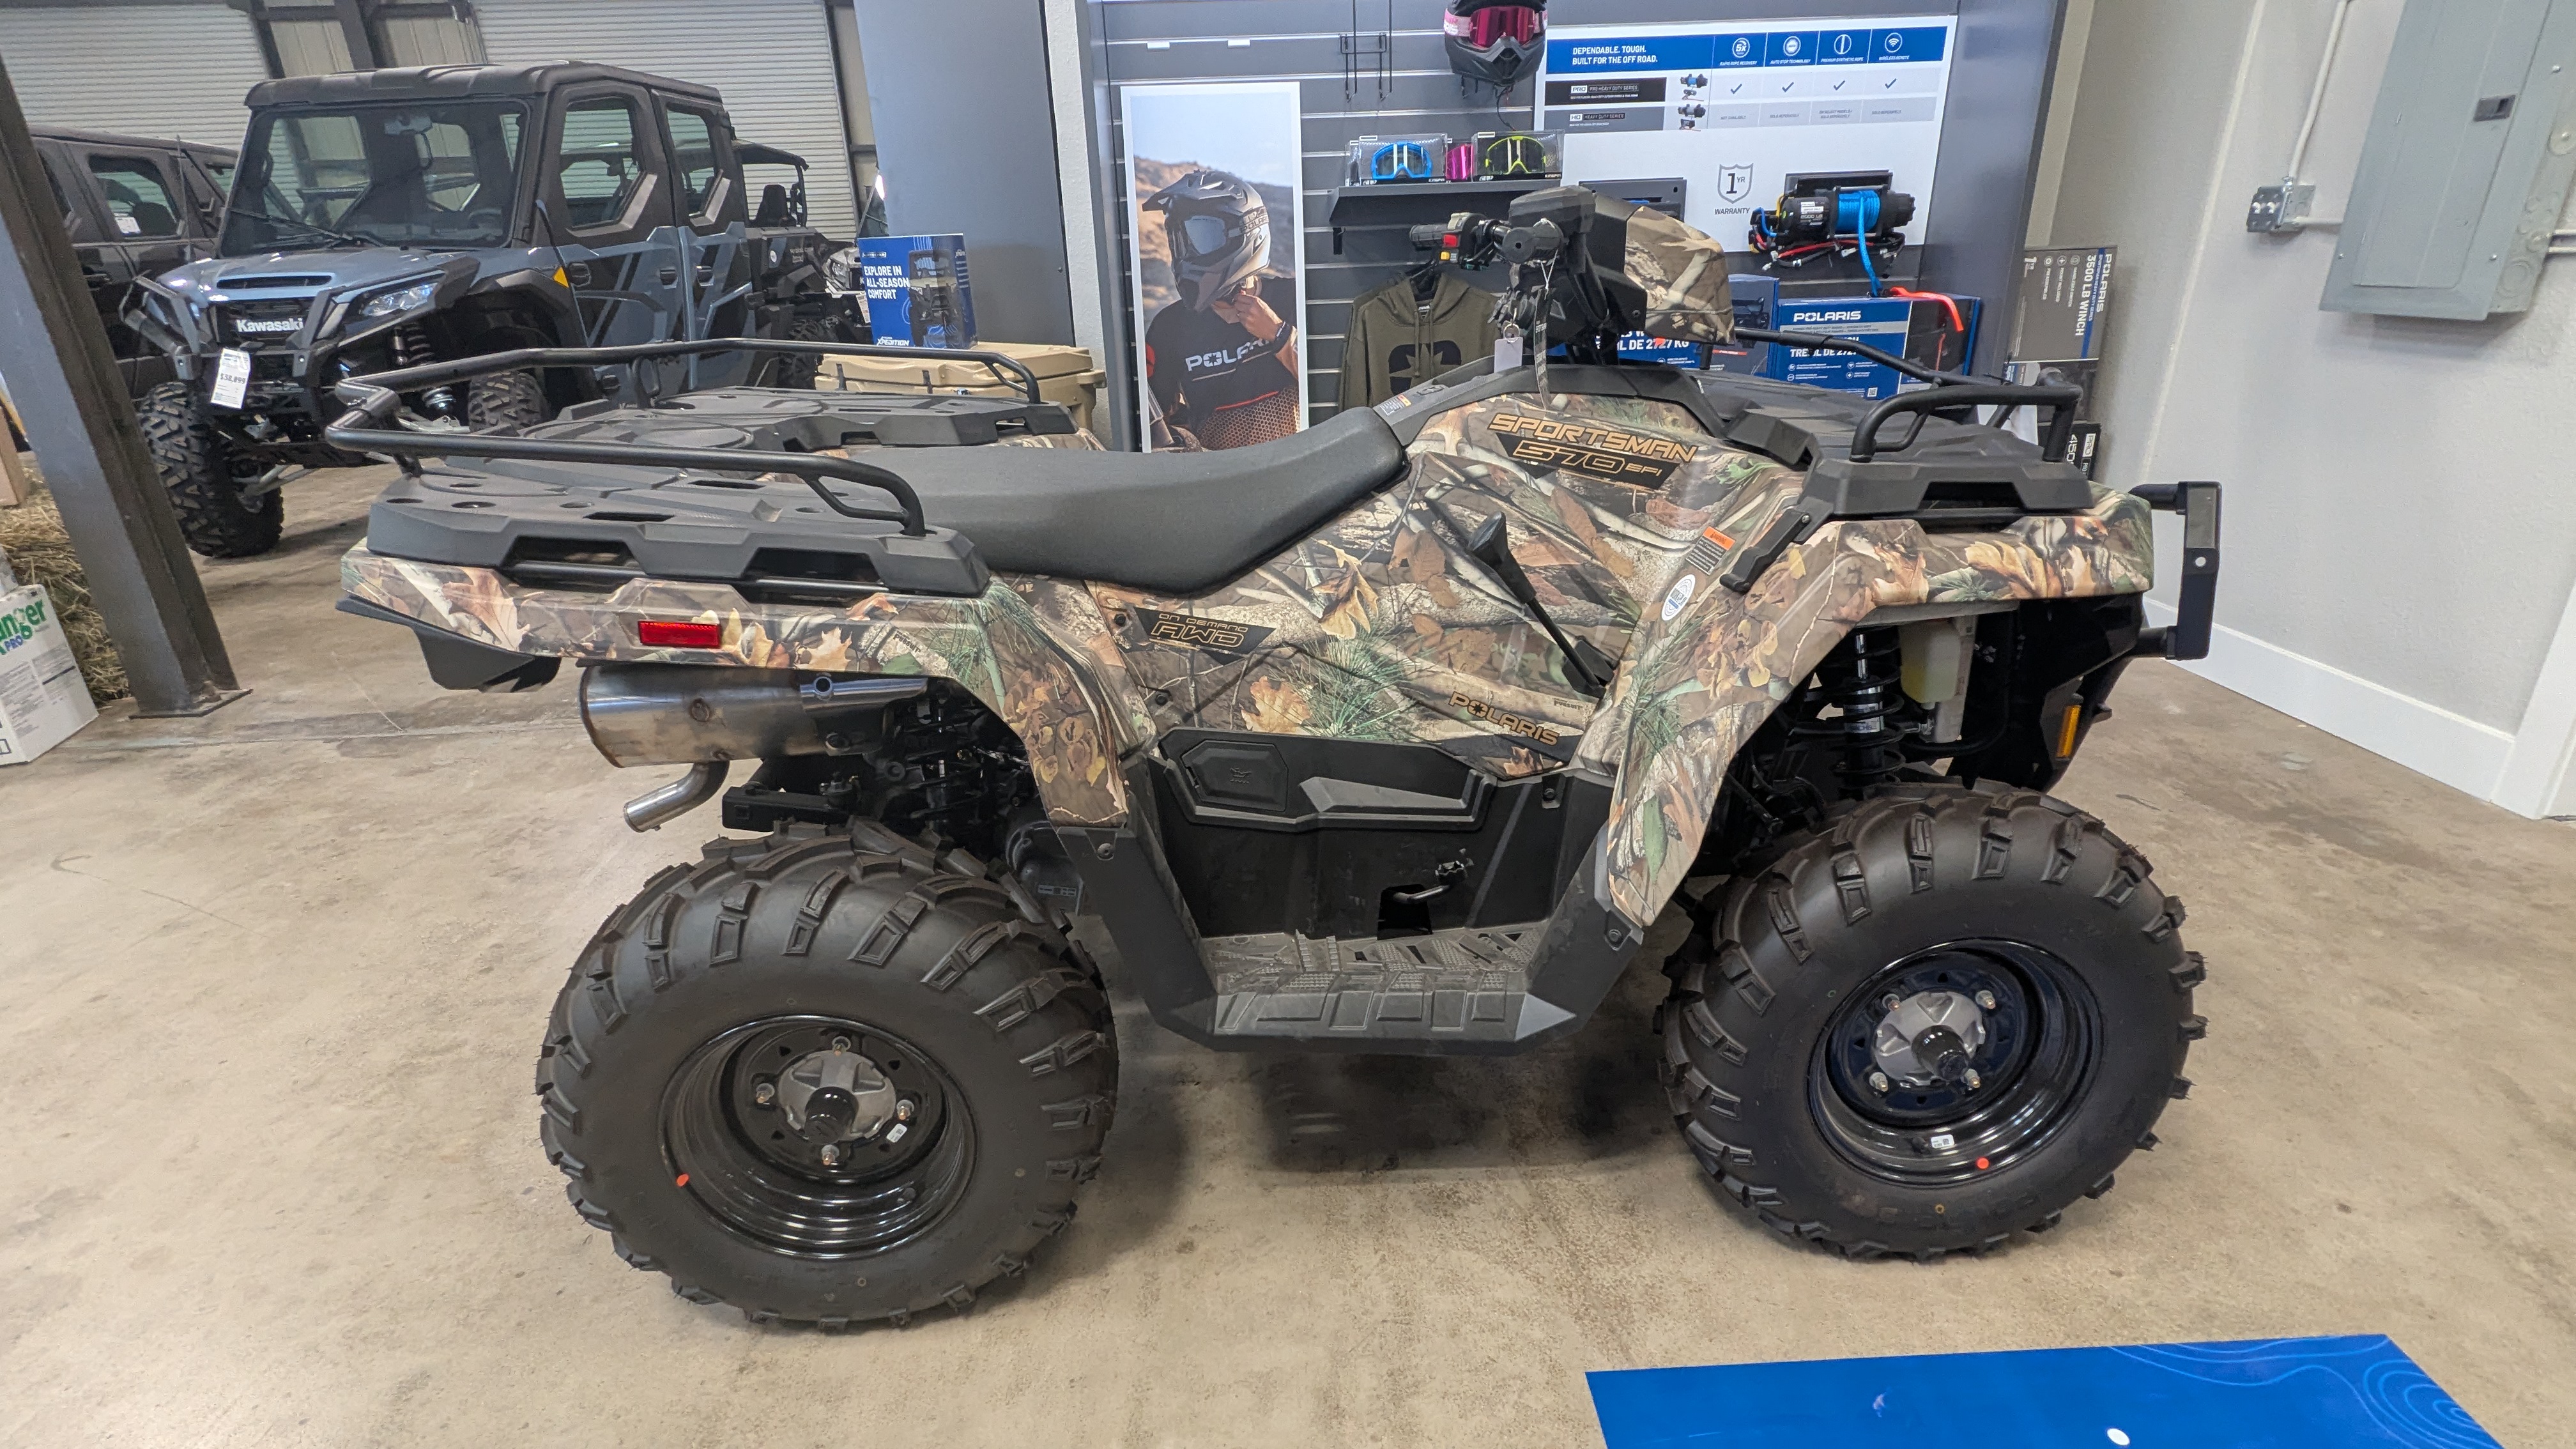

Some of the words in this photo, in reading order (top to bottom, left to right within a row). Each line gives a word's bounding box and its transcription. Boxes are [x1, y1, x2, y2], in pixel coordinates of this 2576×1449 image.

[1572, 47, 1620, 55] DEPENDABLE.
[1572, 57, 1592, 65] BUILT
[1593, 56, 1607, 65] FOR
[1726, 172, 1737, 194] 1
[1239, 217, 1268, 233] POLAR
[864, 266, 892, 276] EXPLORE
[893, 266, 902, 275] IN
[2084, 254, 2096, 282] 3500
[866, 277, 909, 288] ALL-SEASON
[2097, 254, 2113, 312] POLARIS
[868, 289, 896, 299] COMFORT
[2082, 283, 2092, 298] LB
[1793, 310, 1862, 323] POLARIS
[2075, 301, 2089, 336] WINCH
[236, 318, 303, 332] Kawasaki
[877, 336, 910, 346] XPEDITION
[1630, 339, 1644, 350] DE
[1790, 348, 1822, 358] TREIL
[1487, 413, 1698, 463] SPORTSMAN
[2085, 435, 2094, 455] PRO
[2066, 434, 2078, 464] 450
[1513, 440, 1625, 474] 570
[1625, 463, 1662, 477] EFI
[1186, 618, 1248, 632] DEMAND
[1151, 620, 1245, 648] AWD
[1448, 691, 1560, 746] POLARIS
